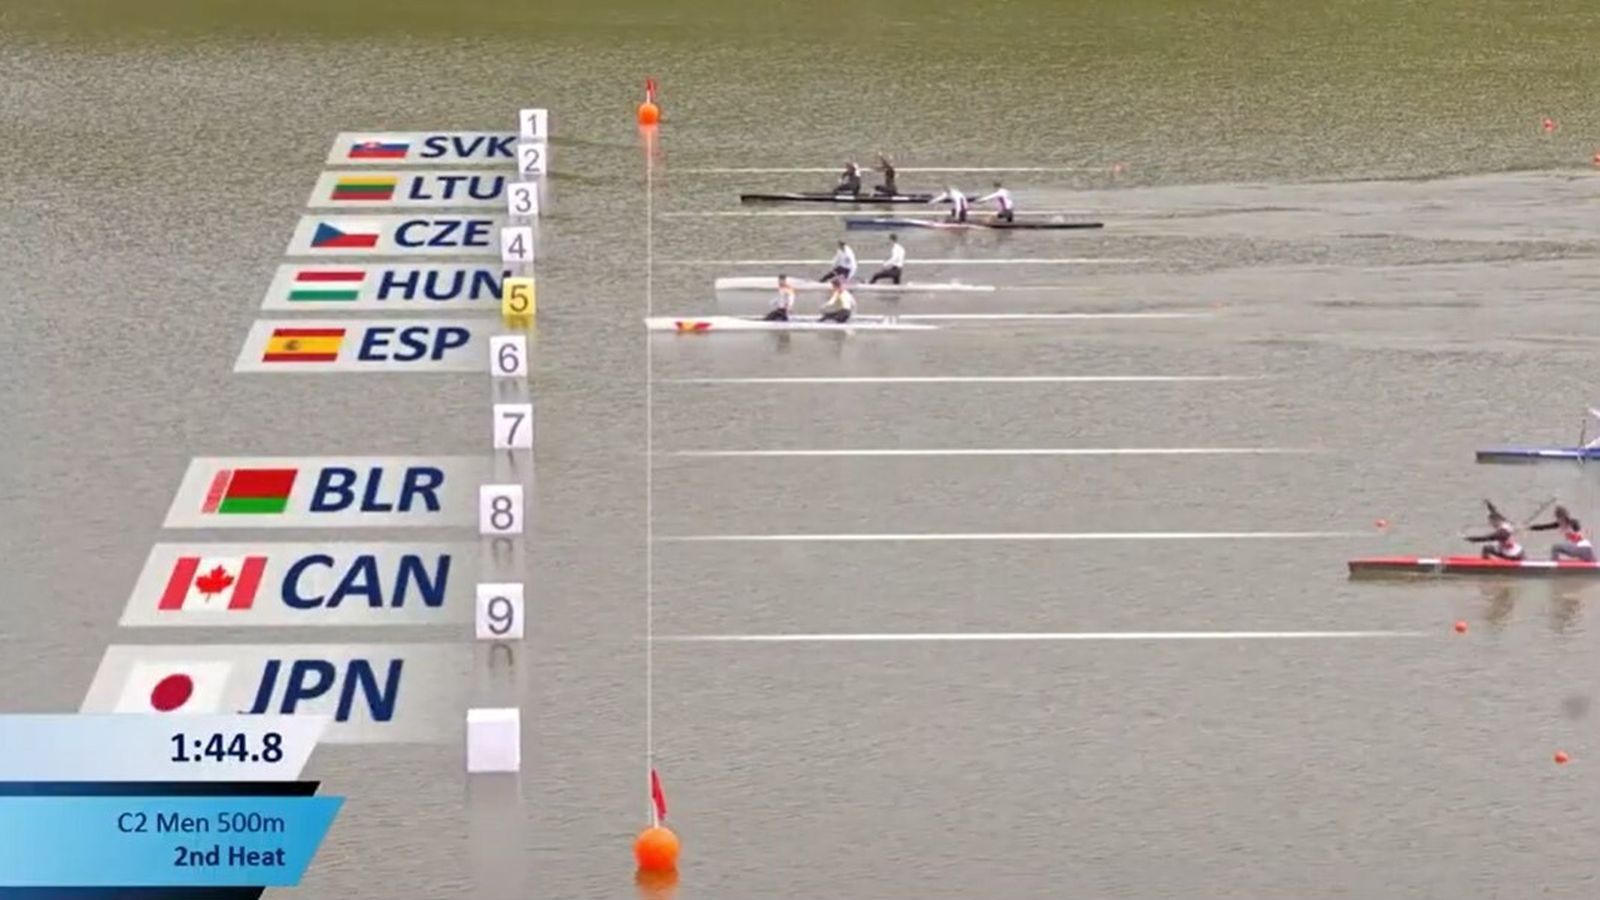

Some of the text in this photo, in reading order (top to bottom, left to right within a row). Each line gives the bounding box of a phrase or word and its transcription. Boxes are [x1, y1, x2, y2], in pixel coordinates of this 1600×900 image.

[525, 149, 539, 172] 2
[516, 189, 531, 212] 3
[508, 234, 526, 258] 4
[509, 284, 529, 312] 5
[499, 344, 518, 373] 6
[504, 413, 524, 445] 7
[491, 496, 513, 530] 8
[488, 597, 513, 635] 9
